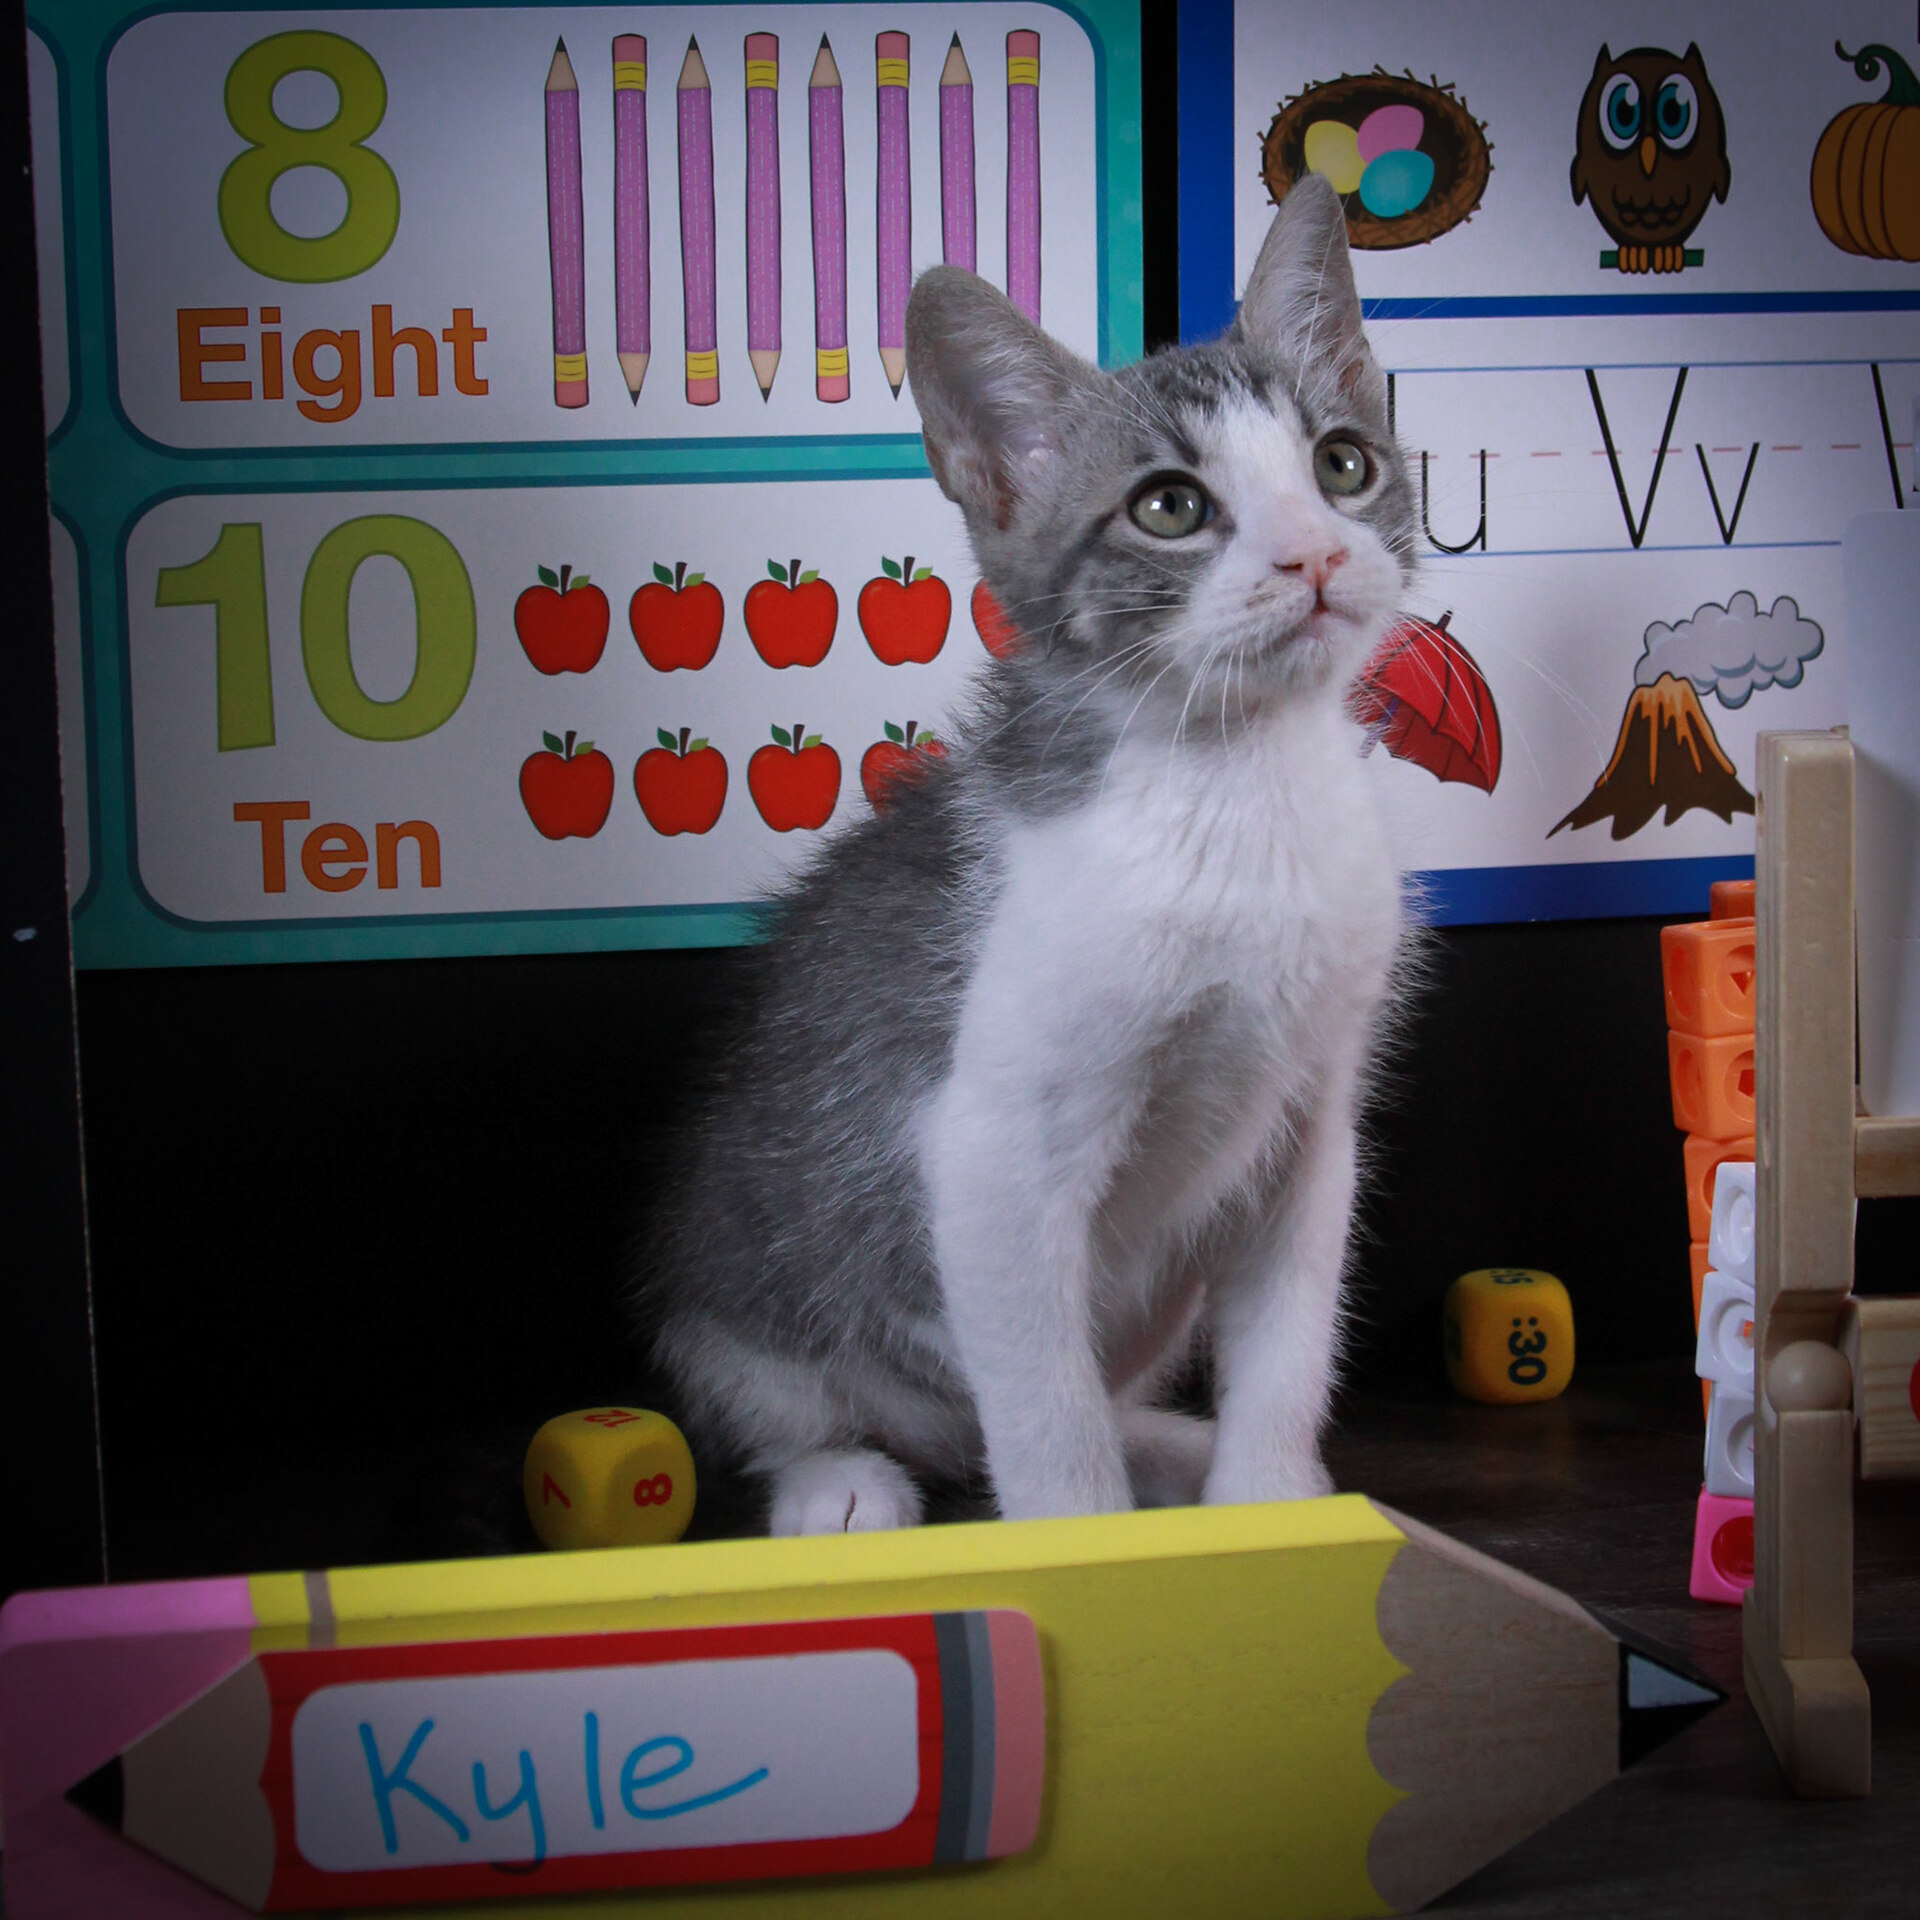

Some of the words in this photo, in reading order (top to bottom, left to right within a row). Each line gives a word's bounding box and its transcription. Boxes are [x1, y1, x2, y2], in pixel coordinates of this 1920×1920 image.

[217, 29, 400, 284] 8
[176, 304, 489, 423] Eight
[154, 513, 477, 752] 10
[233, 801, 442, 894] Ten
[633, 1473, 673, 1508] 8
[359, 1711, 768, 1874] Kyle
